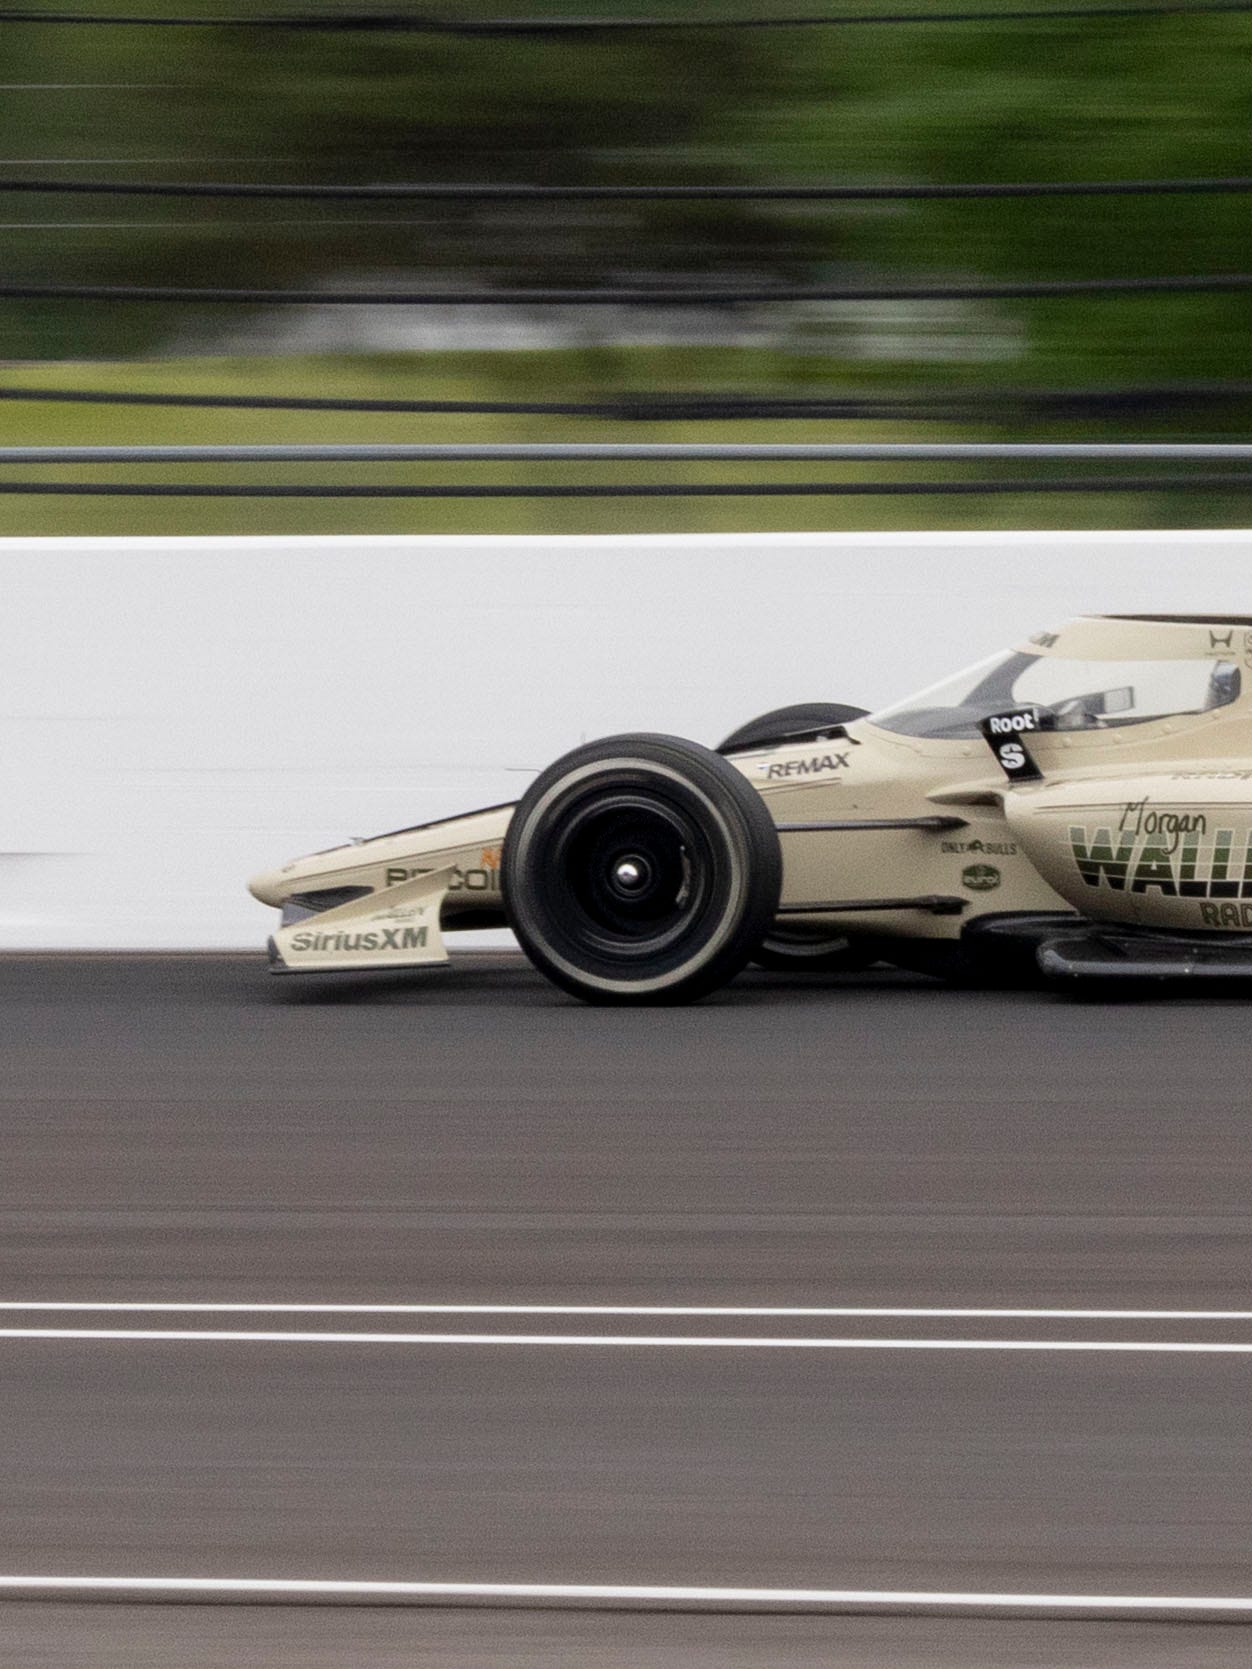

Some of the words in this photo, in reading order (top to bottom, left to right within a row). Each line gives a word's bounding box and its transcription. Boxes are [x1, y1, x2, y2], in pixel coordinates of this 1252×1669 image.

[767, 752, 850, 779] REMAX
[1118, 796, 1206, 855] Morgan
[290, 926, 428, 952] SiriusXM
